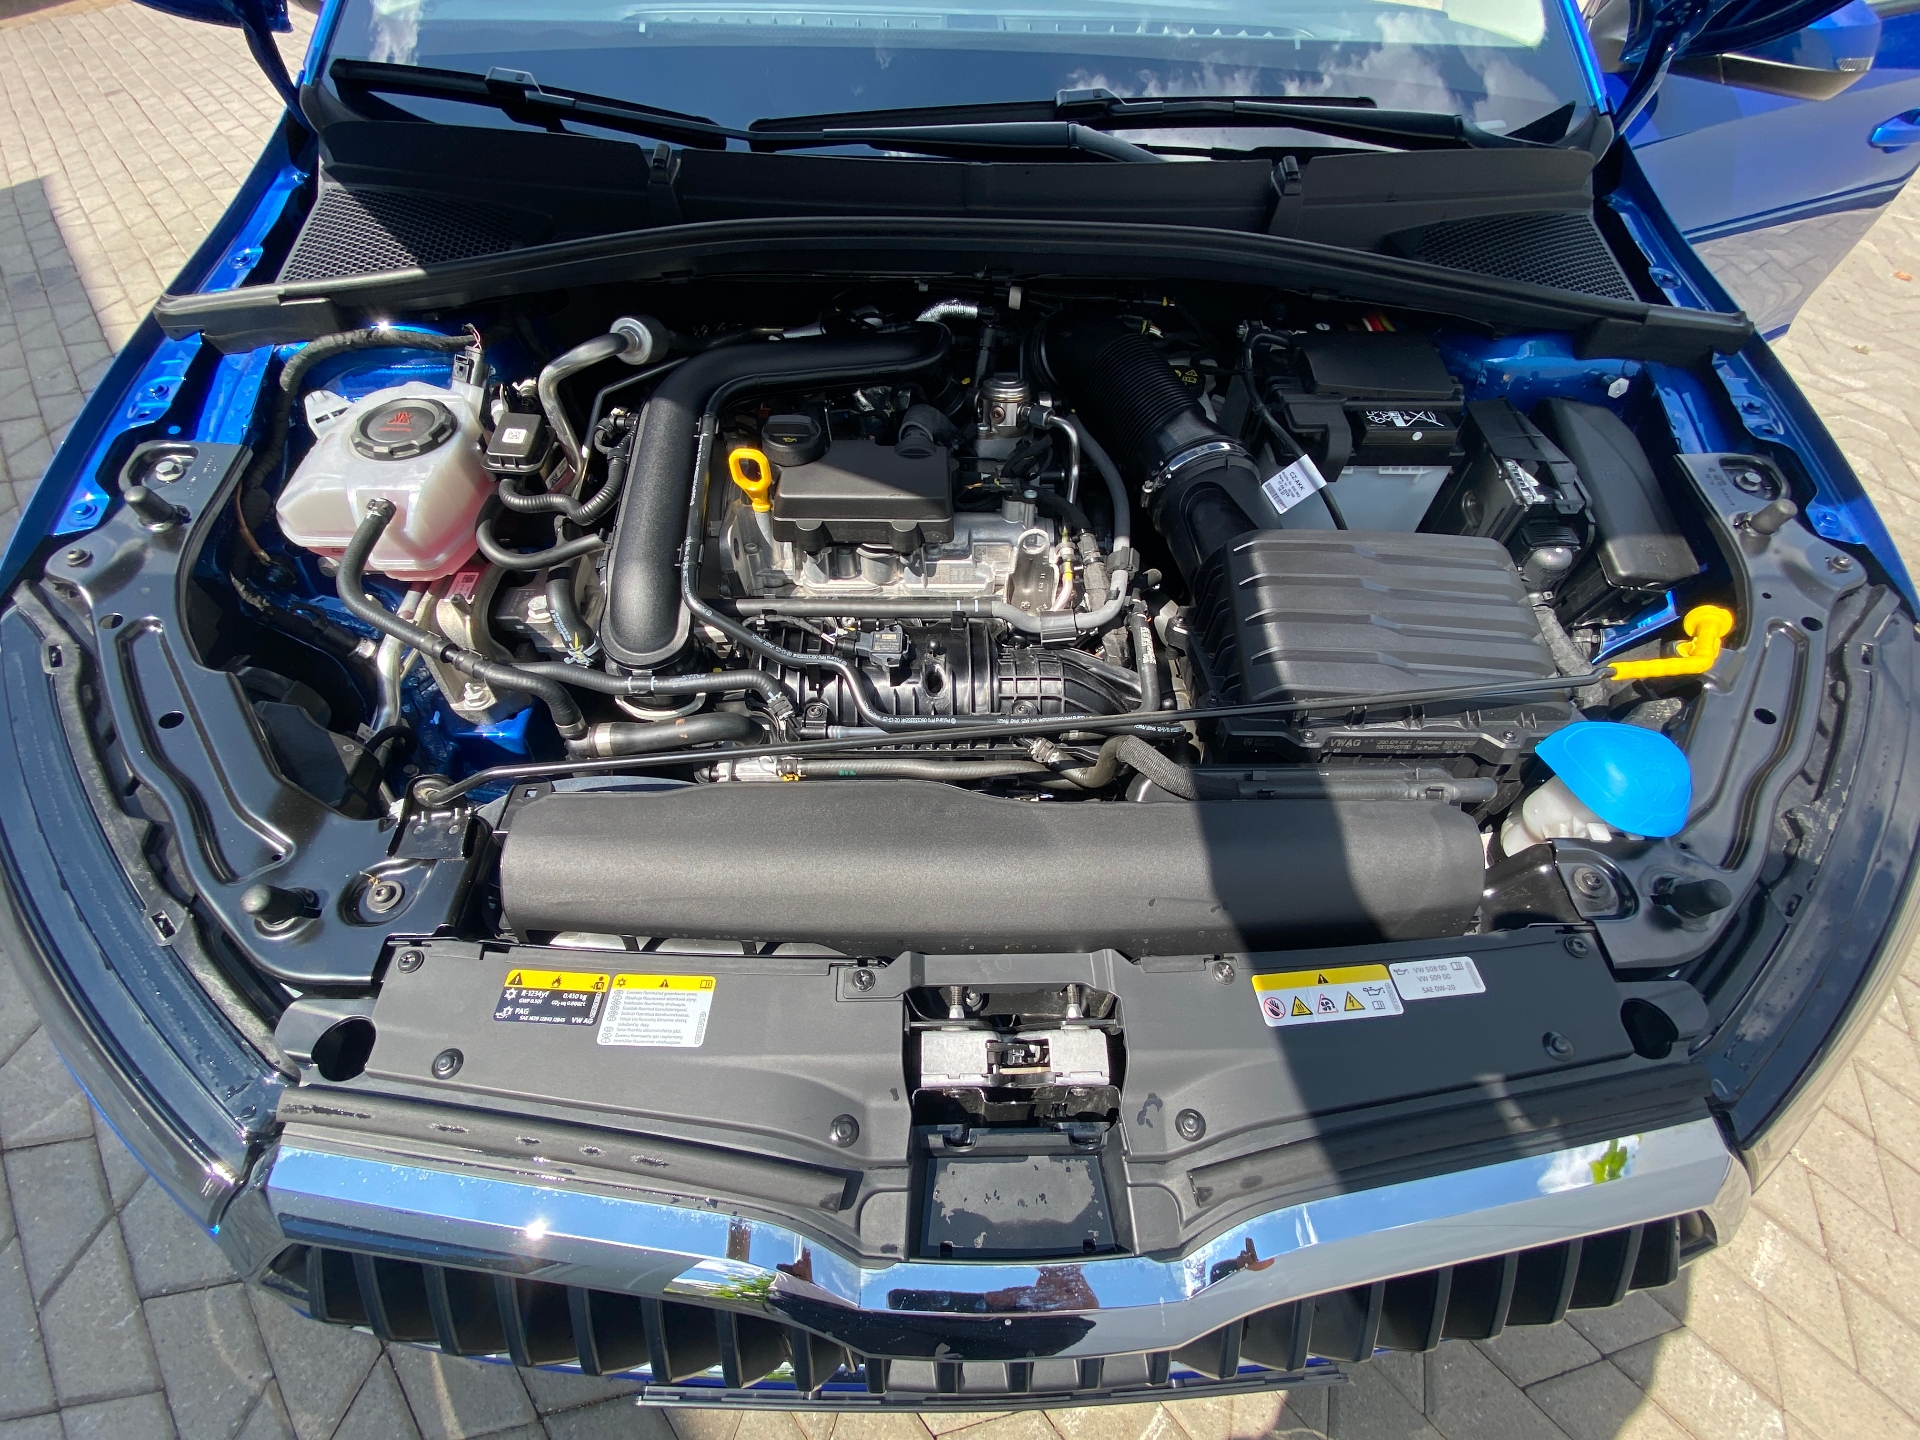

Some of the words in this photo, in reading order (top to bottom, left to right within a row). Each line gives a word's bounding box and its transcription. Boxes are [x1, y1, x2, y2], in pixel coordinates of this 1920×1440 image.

[520, 989, 550, 998] R-1234yf
[1421, 986, 1434, 994] SAE
[1434, 984, 1456, 992] 0W-20
[579, 993, 588, 1001] kg
